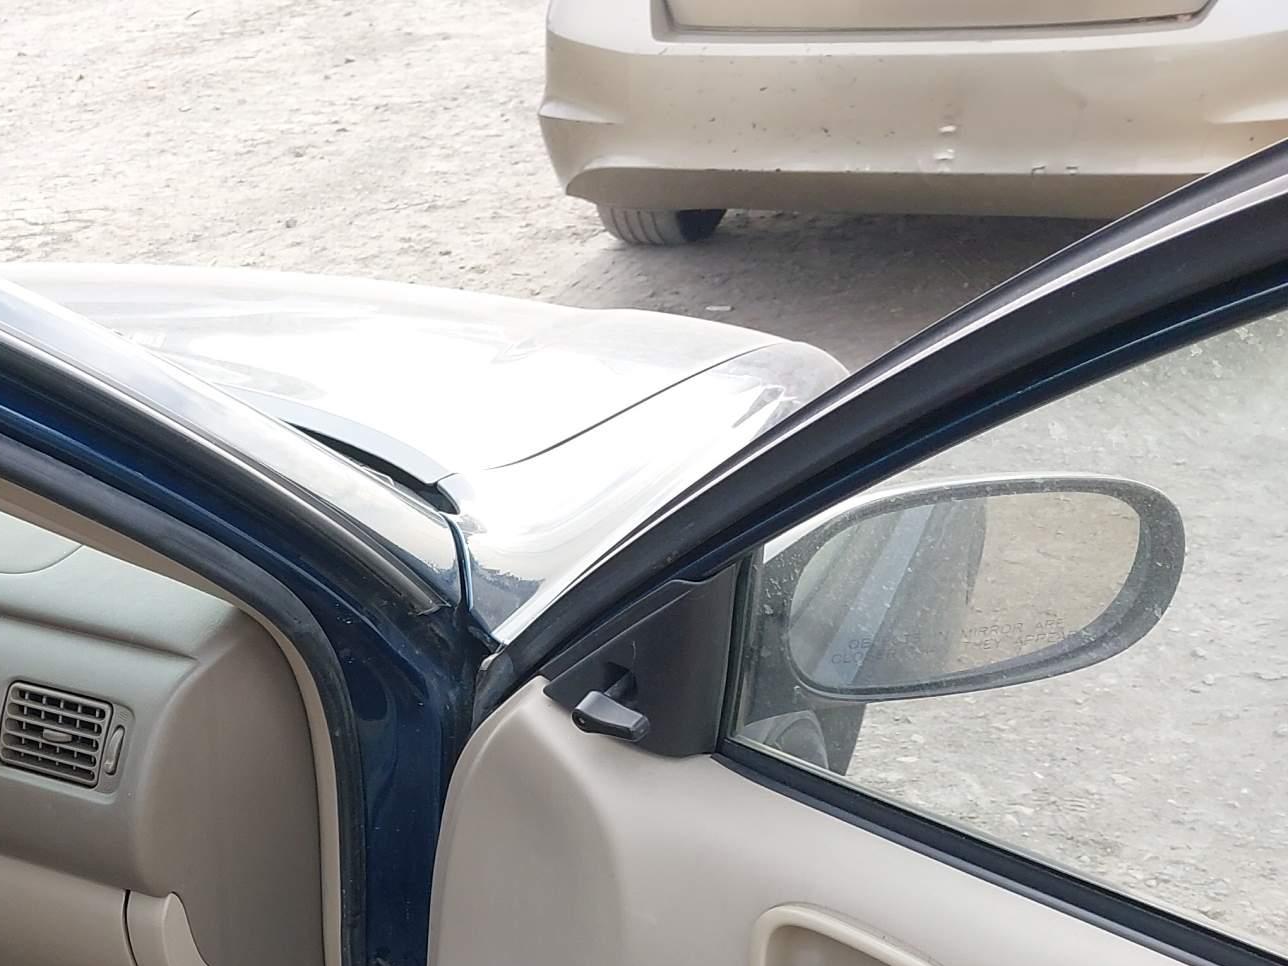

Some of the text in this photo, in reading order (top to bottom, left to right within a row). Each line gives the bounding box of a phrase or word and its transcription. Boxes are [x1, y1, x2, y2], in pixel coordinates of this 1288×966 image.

[848, 632, 921, 650] OBTS
[961, 623, 1024, 638] MIRROR
[1035, 617, 1065, 630] ARE
